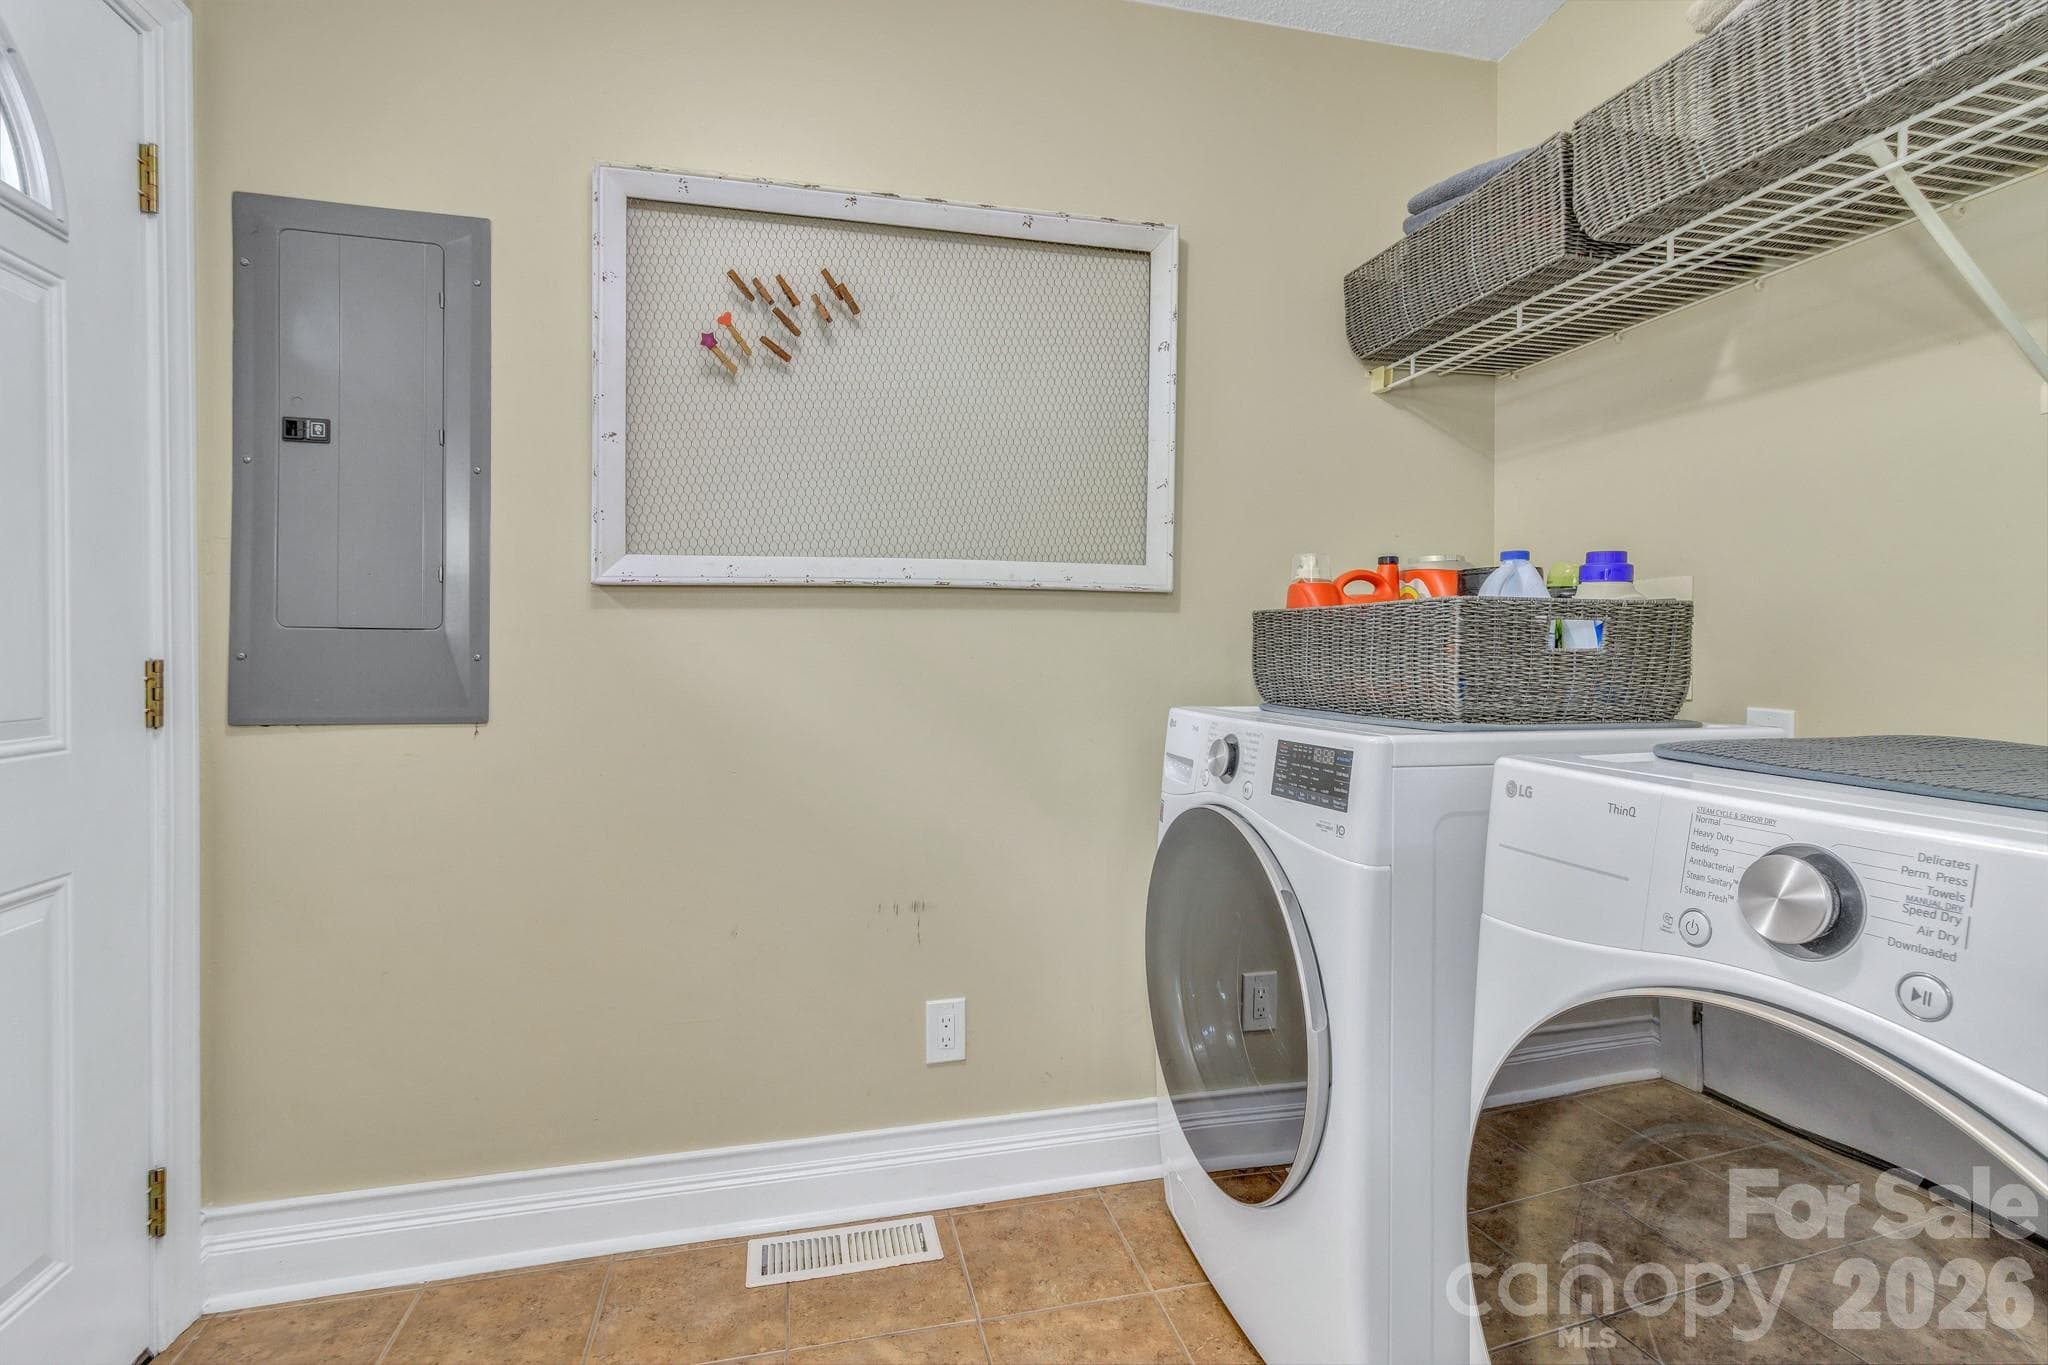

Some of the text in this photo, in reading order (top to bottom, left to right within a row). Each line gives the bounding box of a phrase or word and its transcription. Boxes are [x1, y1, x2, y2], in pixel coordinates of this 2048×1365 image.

[1607, 802, 1636, 818] ThinQ
[1696, 806, 1715, 815] STEAM
[1715, 809, 1734, 818] CYCLE
[1740, 813, 1763, 823] SENSOR
[1764, 817, 1777, 826] DRY
[1695, 814, 1721, 826] Normal
[1693, 828, 1734, 843] Heavy Duty
[1690, 841, 1719, 856] Bedding
[1688, 856, 1735, 874] Antibacterial
[1917, 852, 1971, 870] Delicates
[1686, 871, 1706, 883] Steam
[1901, 865, 1968, 886] Perm. Press
[1684, 885, 1707, 899] Steam
[1927, 885, 1966, 902] Towels
[1905, 895, 1964, 914] MANUAL DRY
[1902, 903, 1963, 927] Speed Dry
[1916, 926, 1960, 946] Air Dry
[1887, 936, 1957, 962] Downloaded
